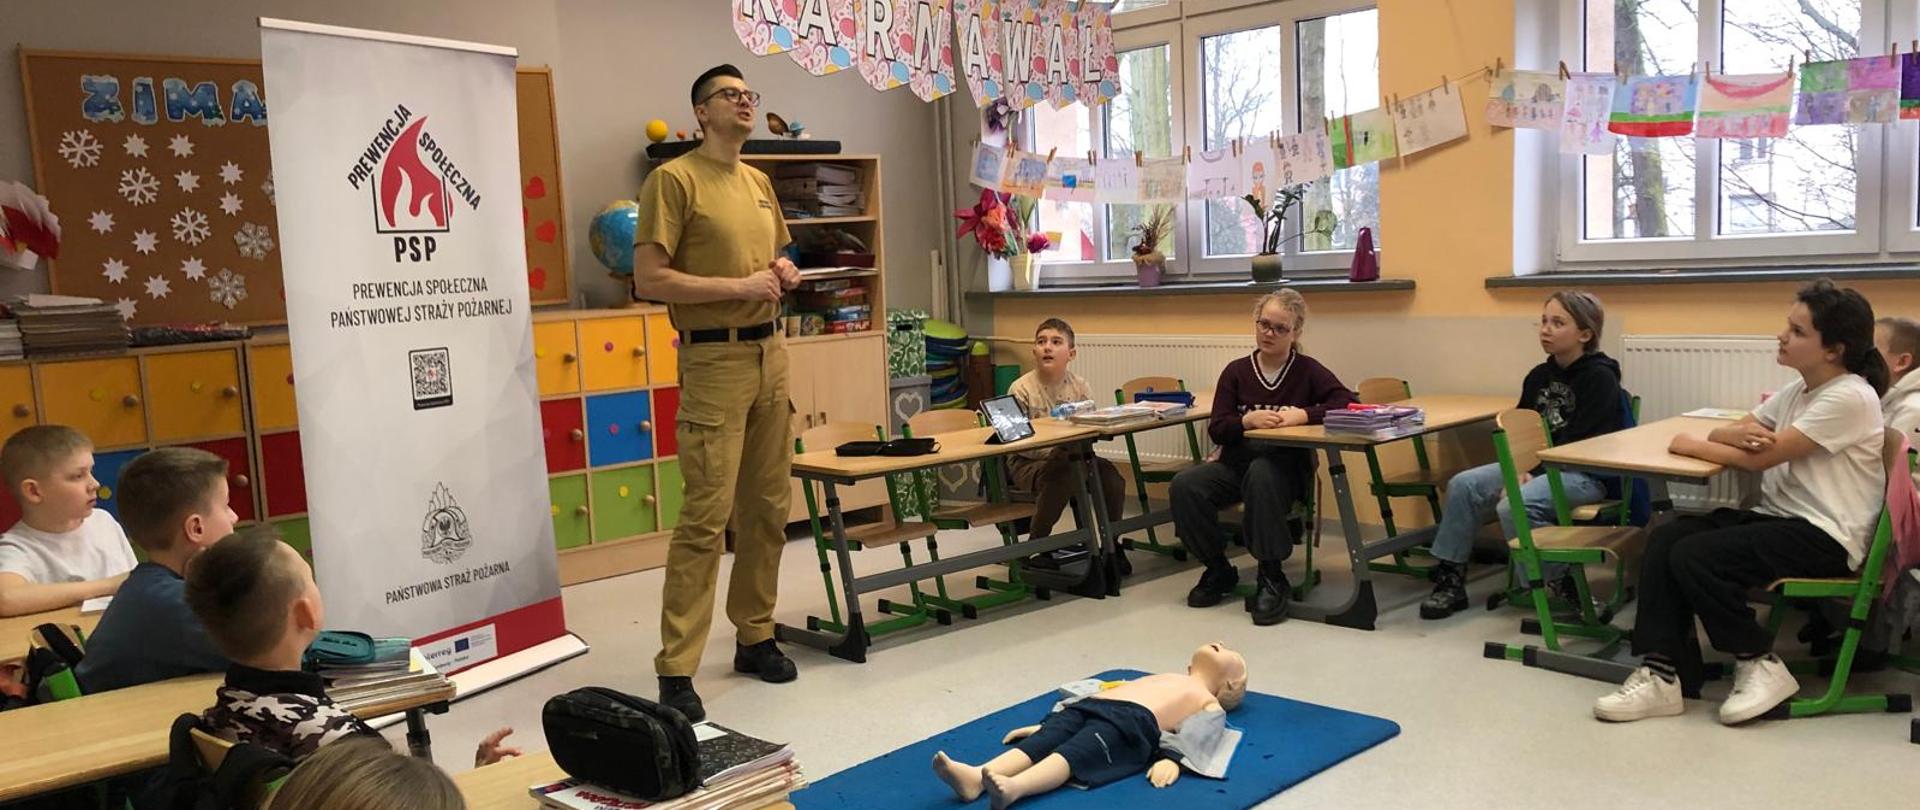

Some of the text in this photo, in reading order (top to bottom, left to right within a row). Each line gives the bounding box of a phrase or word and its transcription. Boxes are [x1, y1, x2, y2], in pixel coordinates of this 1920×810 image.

[80, 74, 268, 128] ZIMA
[347, 103, 412, 190] PREWENCJA
[418, 131, 481, 211] SPOŁECZNA
[394, 236, 437, 263] PSP
[353, 277, 488, 300] PREWENCJA SPOŁECZNA
[330, 297, 512, 328] PAŃSTWOWEJ STRAŻY POŻARNEJ
[385, 560, 510, 605] PAŃSTWOWA STRAŻ POŻARNA
